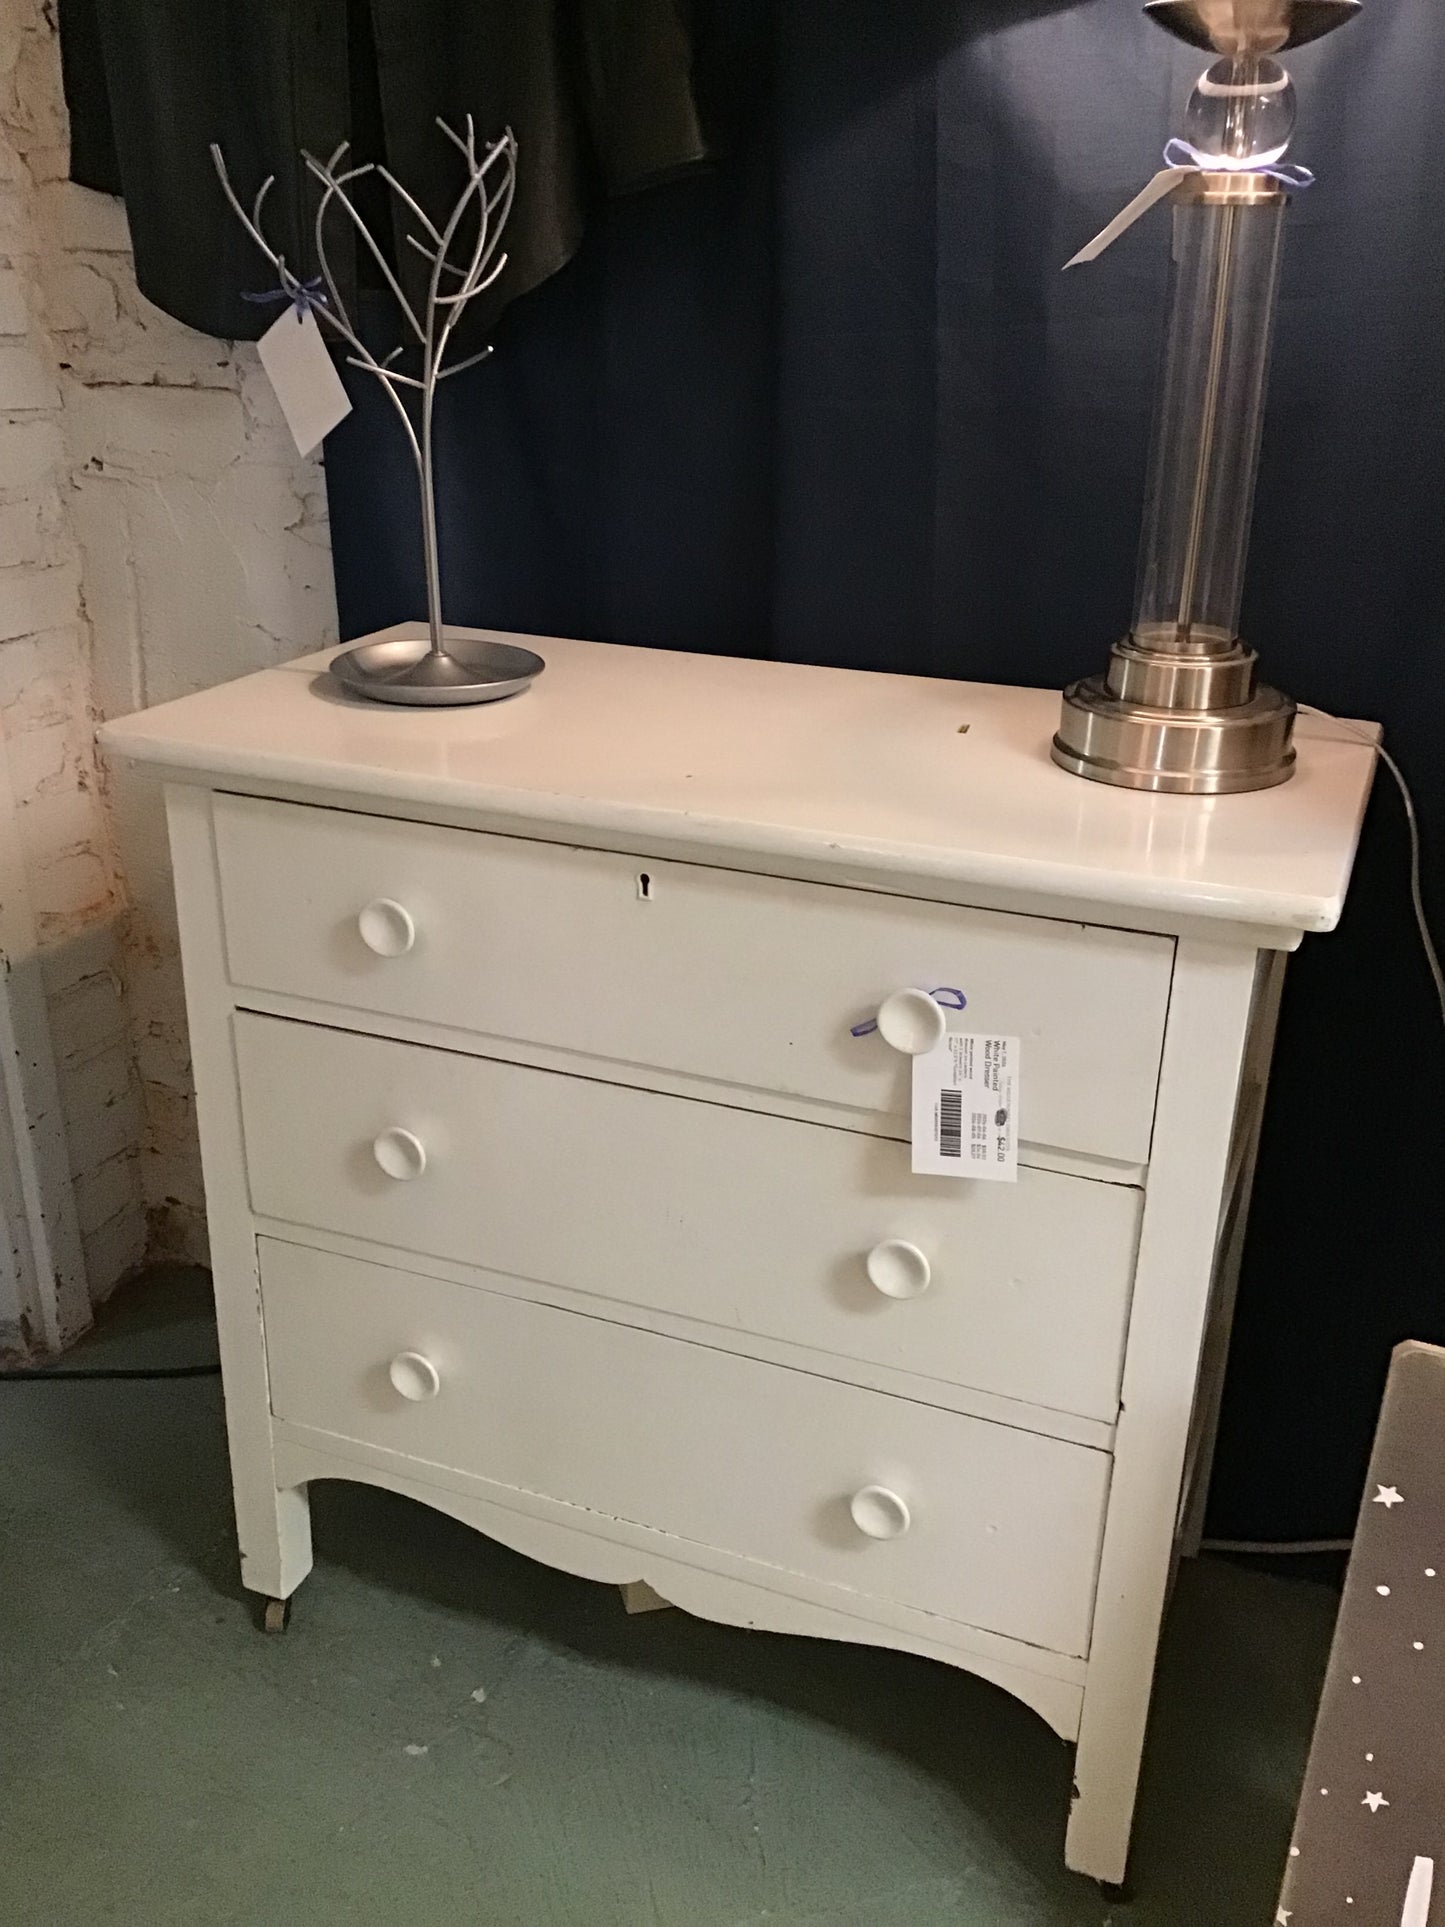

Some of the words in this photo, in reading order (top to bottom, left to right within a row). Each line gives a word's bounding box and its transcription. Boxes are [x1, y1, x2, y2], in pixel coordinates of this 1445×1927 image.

[984, 1039, 993, 1061] Wood
[993, 1040, 1001, 1063] White
[983, 1062, 992, 1088] Dresser
[992, 1064, 1000, 1092] Painted
[996, 1136, 1006, 1163] $42.00
